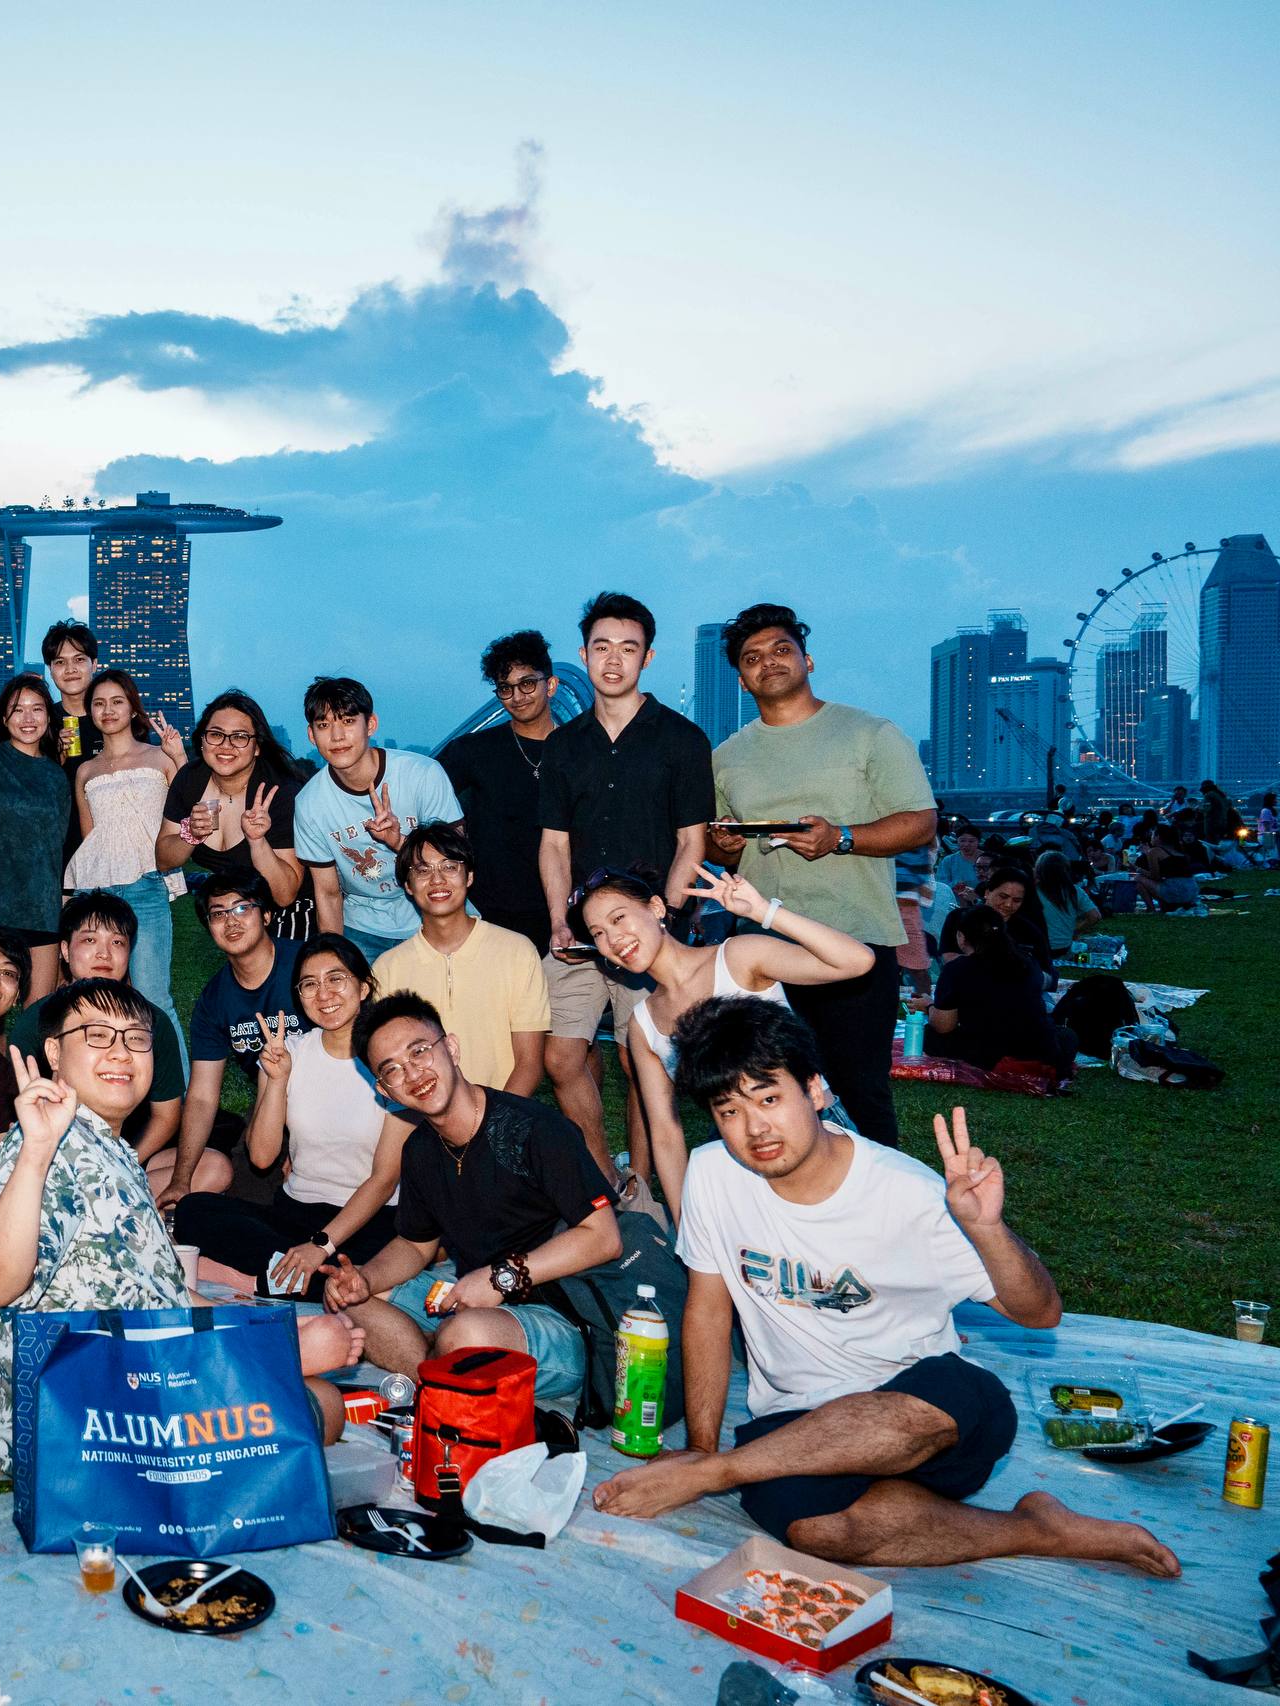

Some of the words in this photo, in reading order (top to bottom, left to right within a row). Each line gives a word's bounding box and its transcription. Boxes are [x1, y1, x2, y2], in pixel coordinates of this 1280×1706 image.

[739, 1246, 874, 1305] FILA
[139, 1372, 161, 1383] NUS
[167, 1370, 191, 1380] Alumni
[168, 1378, 198, 1388] Relations
[82, 1402, 276, 1448] ALUMNUS
[81, 1450, 133, 1464] NATIONAL
[135, 1454, 195, 1468] UNIVERSITY
[198, 1452, 212, 1465] OF
[215, 1443, 280, 1462] SINGAPORE
[148, 1470, 185, 1482] FOUNDED
[185, 1470, 208, 1481] 1905
